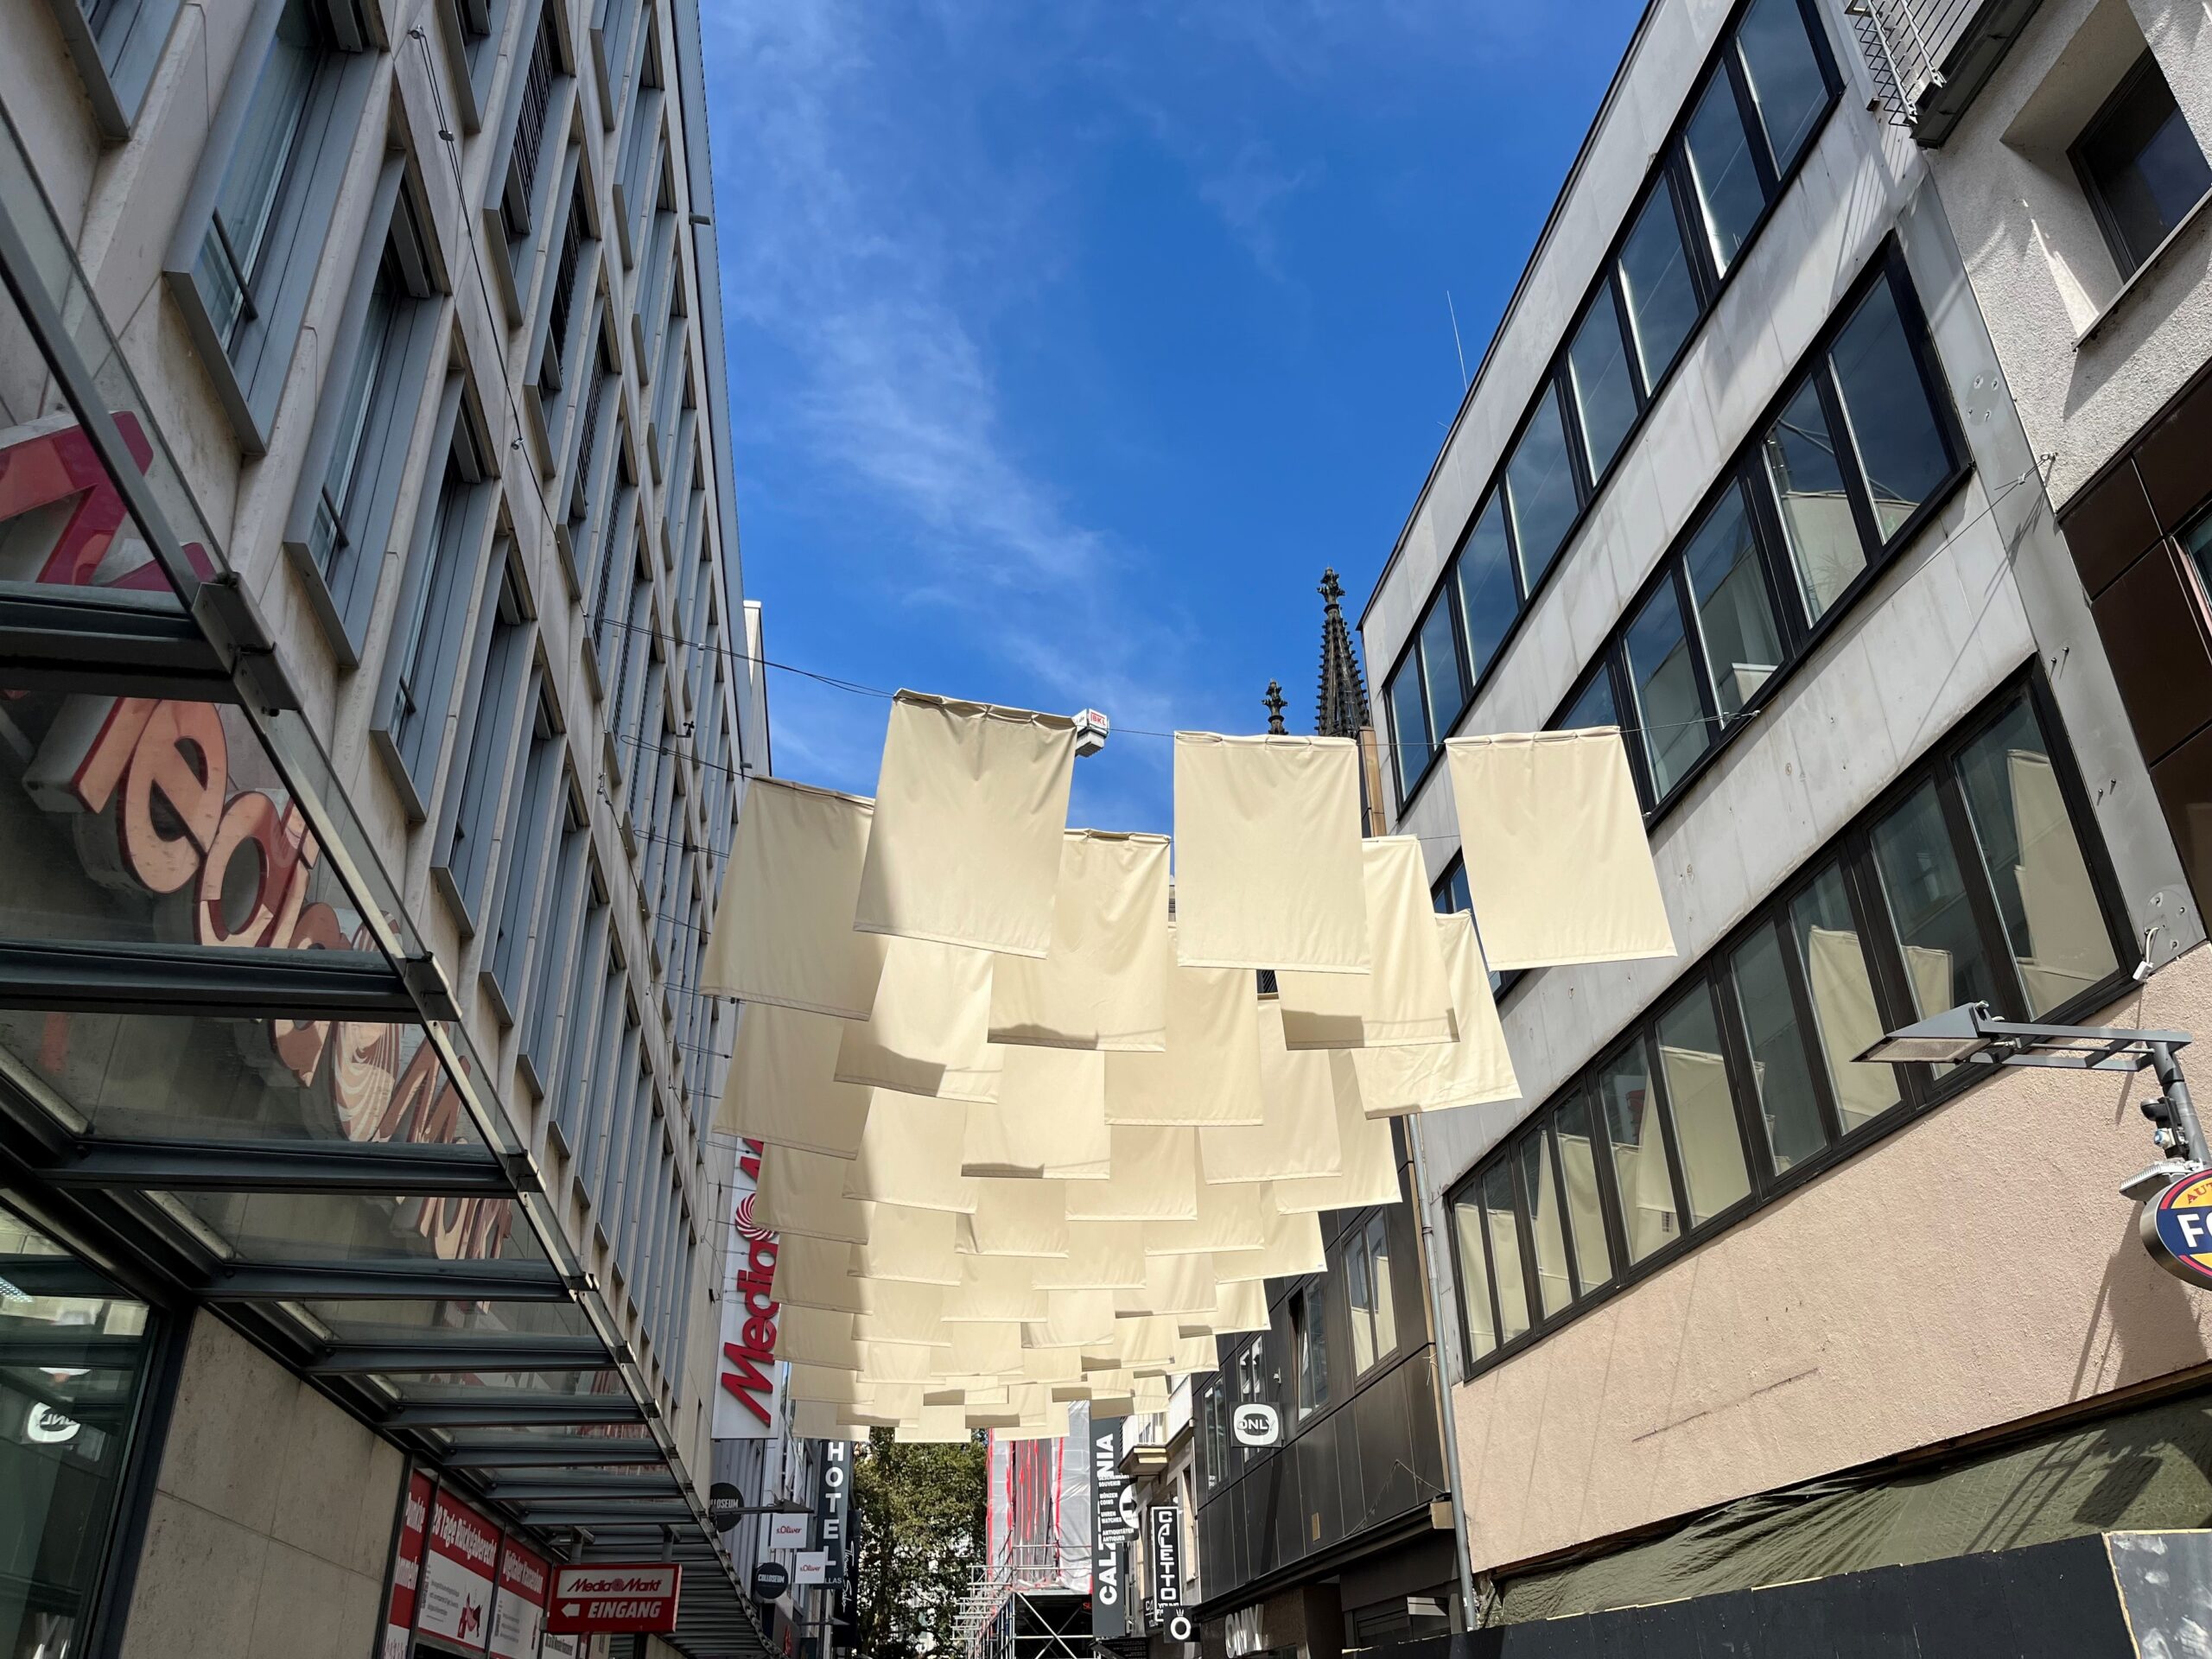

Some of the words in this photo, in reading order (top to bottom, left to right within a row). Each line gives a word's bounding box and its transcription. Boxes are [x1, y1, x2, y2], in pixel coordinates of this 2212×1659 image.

[721, 1239, 779, 1428] Media
[1236, 1419, 1275, 1431] ONLY
[440, 1509, 457, 1548] Tage
[823, 1442, 843, 1566] HOTEL
[1096, 1433, 1117, 1605] CALZNIA
[1158, 1510, 1176, 1600] CALETTO
[588, 1601, 662, 1618] EINGANG
